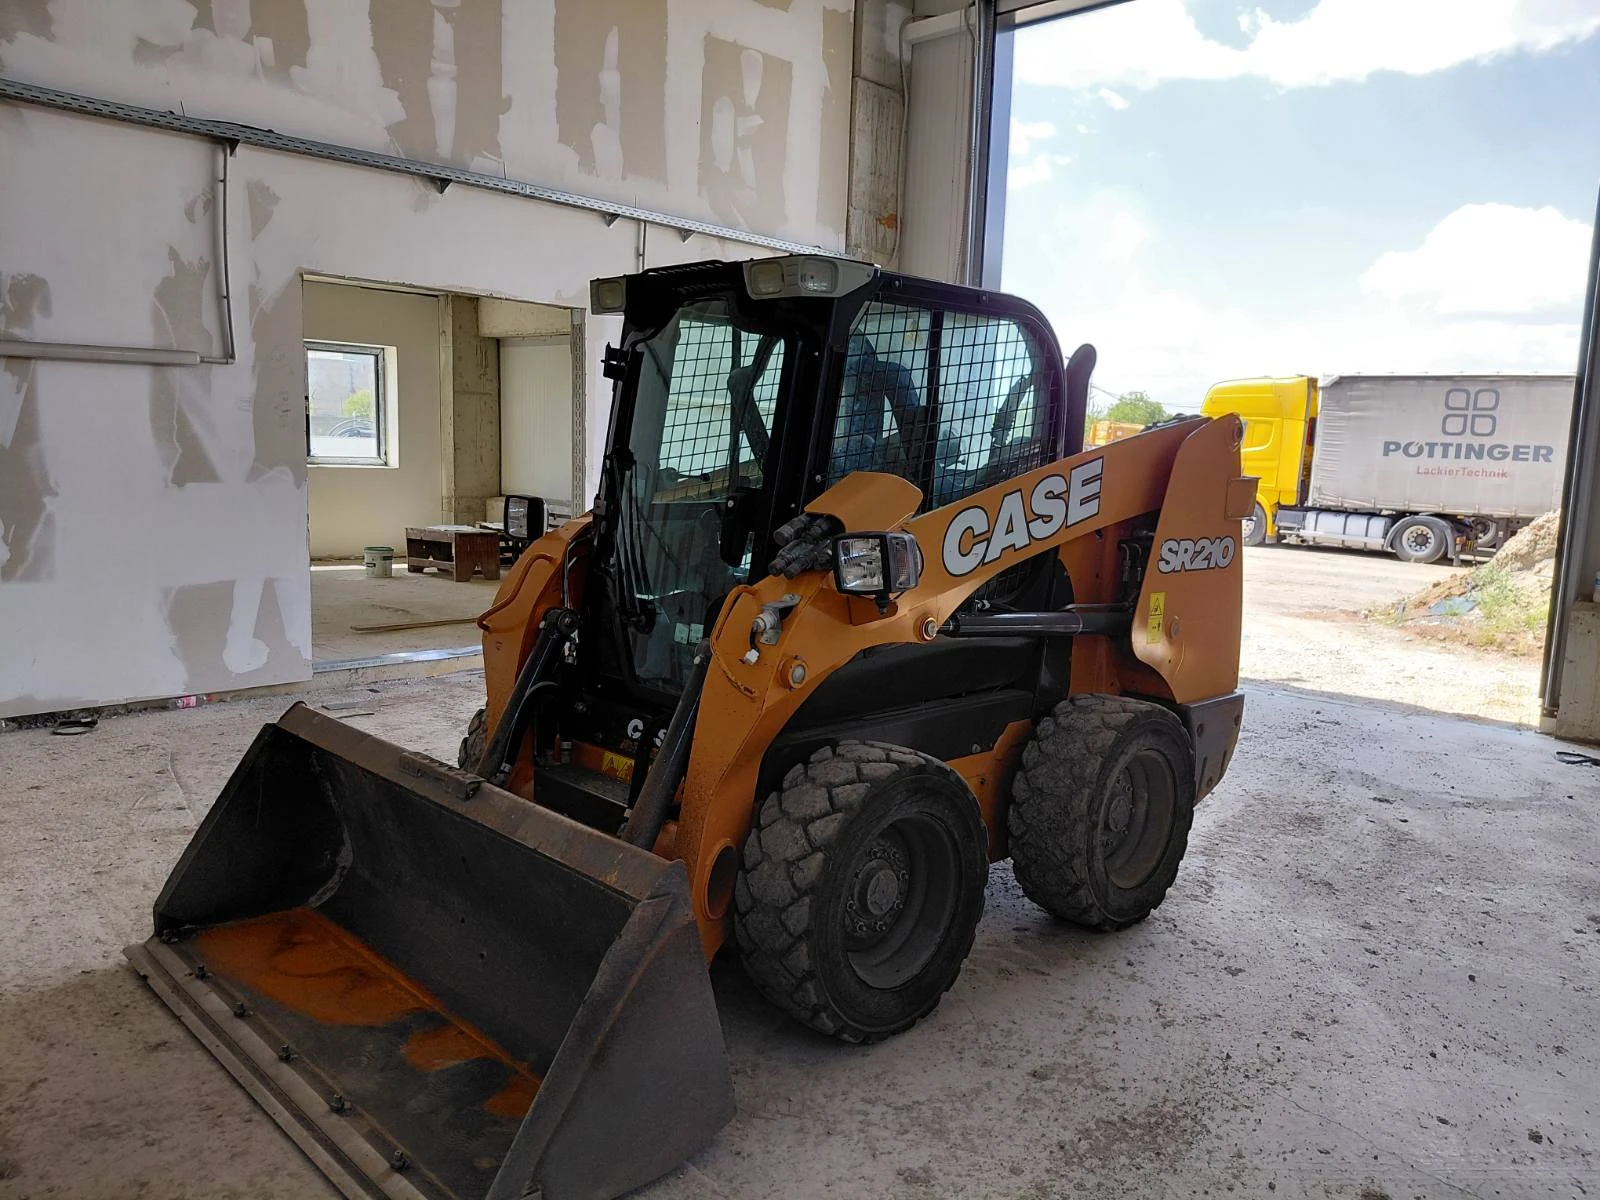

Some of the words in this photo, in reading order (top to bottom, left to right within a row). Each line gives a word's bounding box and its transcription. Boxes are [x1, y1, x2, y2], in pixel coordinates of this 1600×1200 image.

[1416, 465, 1509, 479] LackierTechnik
[942, 455, 1104, 577] CASE
[1158, 536, 1235, 574] SR210
